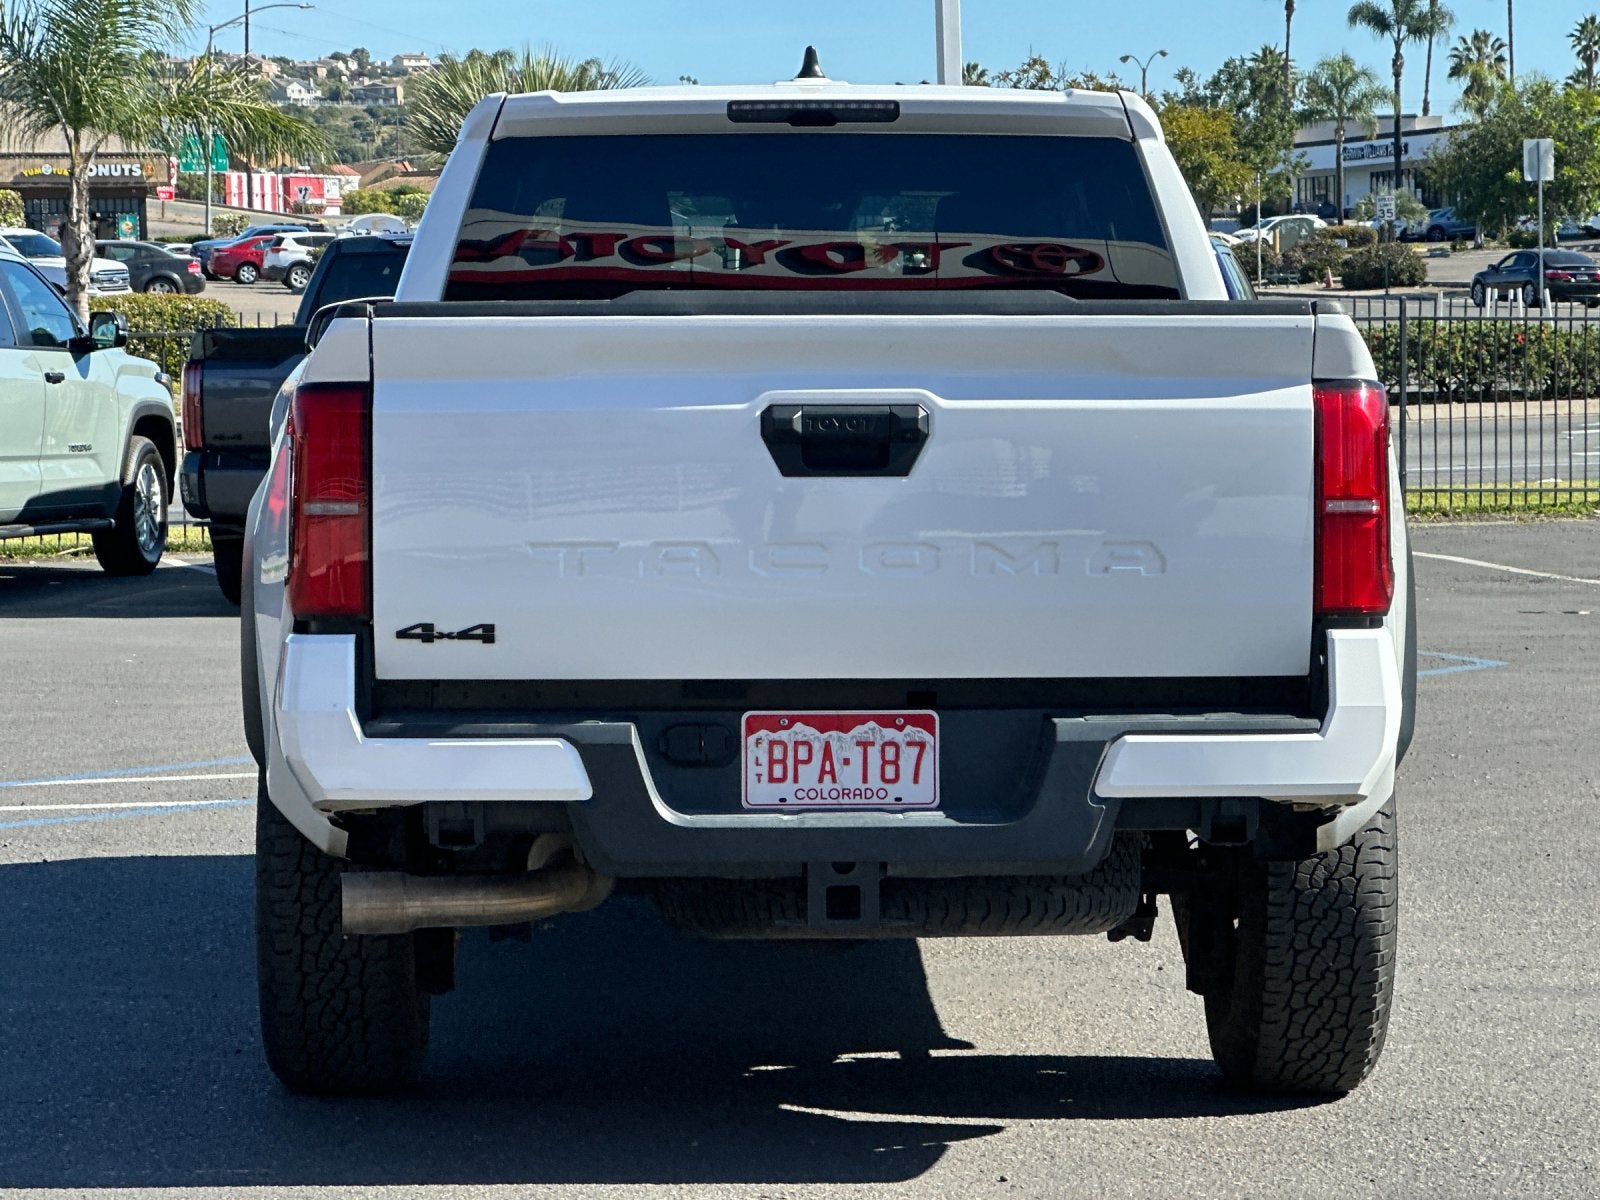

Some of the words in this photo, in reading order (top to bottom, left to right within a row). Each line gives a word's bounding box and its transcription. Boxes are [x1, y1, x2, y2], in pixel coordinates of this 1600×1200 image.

[22, 168, 42, 177] YUM
[87, 163, 142, 177] ONUTS
[1378, 208, 1394, 218] 35
[525, 540, 1167, 577] TACOMA
[794, 788, 888, 800] COLORADO
